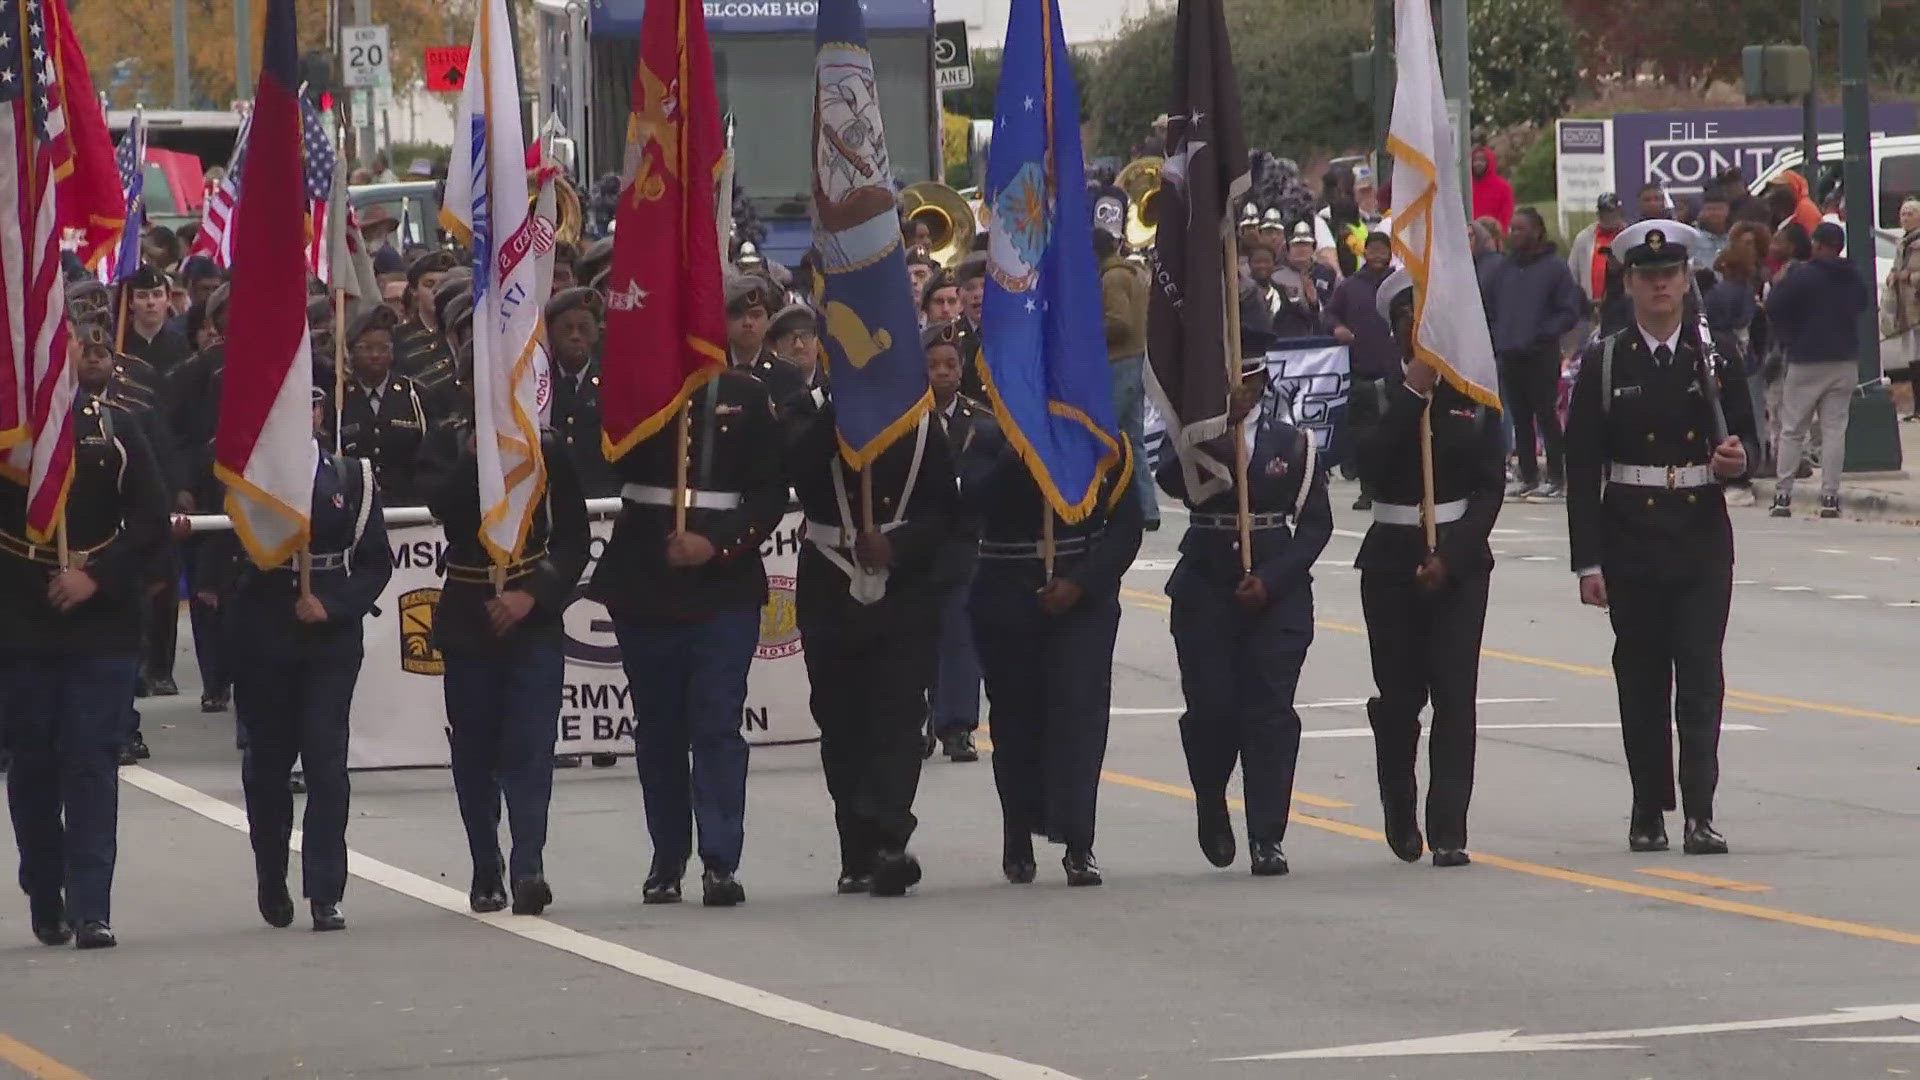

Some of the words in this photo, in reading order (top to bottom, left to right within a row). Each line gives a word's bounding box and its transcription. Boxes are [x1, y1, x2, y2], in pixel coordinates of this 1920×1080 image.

[703, 3, 781, 16] ELCOME
[786, 2, 819, 16] HO
[350, 44, 382, 67] 20
[940, 70, 966, 84] ANE
[1645, 146, 1796, 184] KONT
[561, 684, 630, 709] RMY
[593, 716, 635, 740] BA
